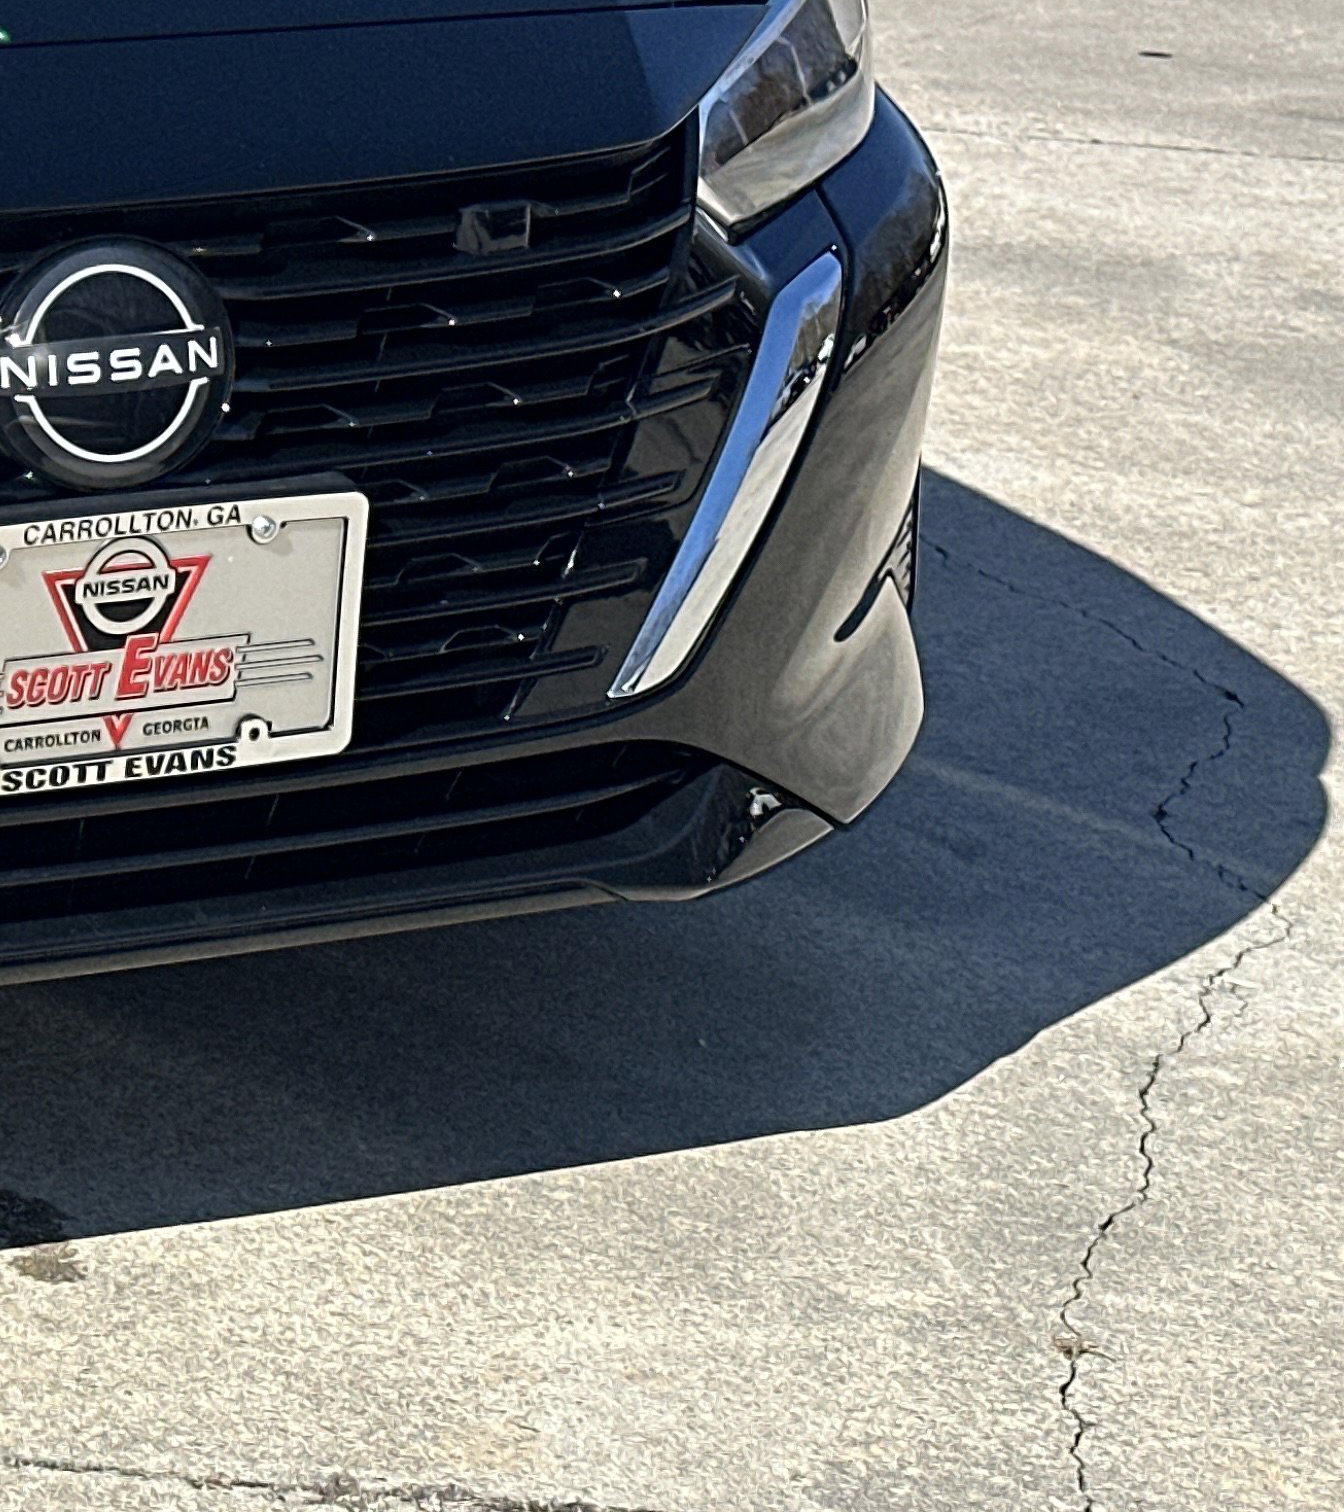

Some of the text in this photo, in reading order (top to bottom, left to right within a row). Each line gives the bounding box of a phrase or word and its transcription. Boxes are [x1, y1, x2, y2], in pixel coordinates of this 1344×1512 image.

[207, 504, 242, 526] GA
[83, 574, 169, 598] NISSAN
[5, 633, 234, 709] SCOTT EVANS
[4, 716, 209, 753] CARROLLTON GEORGIA
[1, 745, 237, 792] SCOTT EVANS
